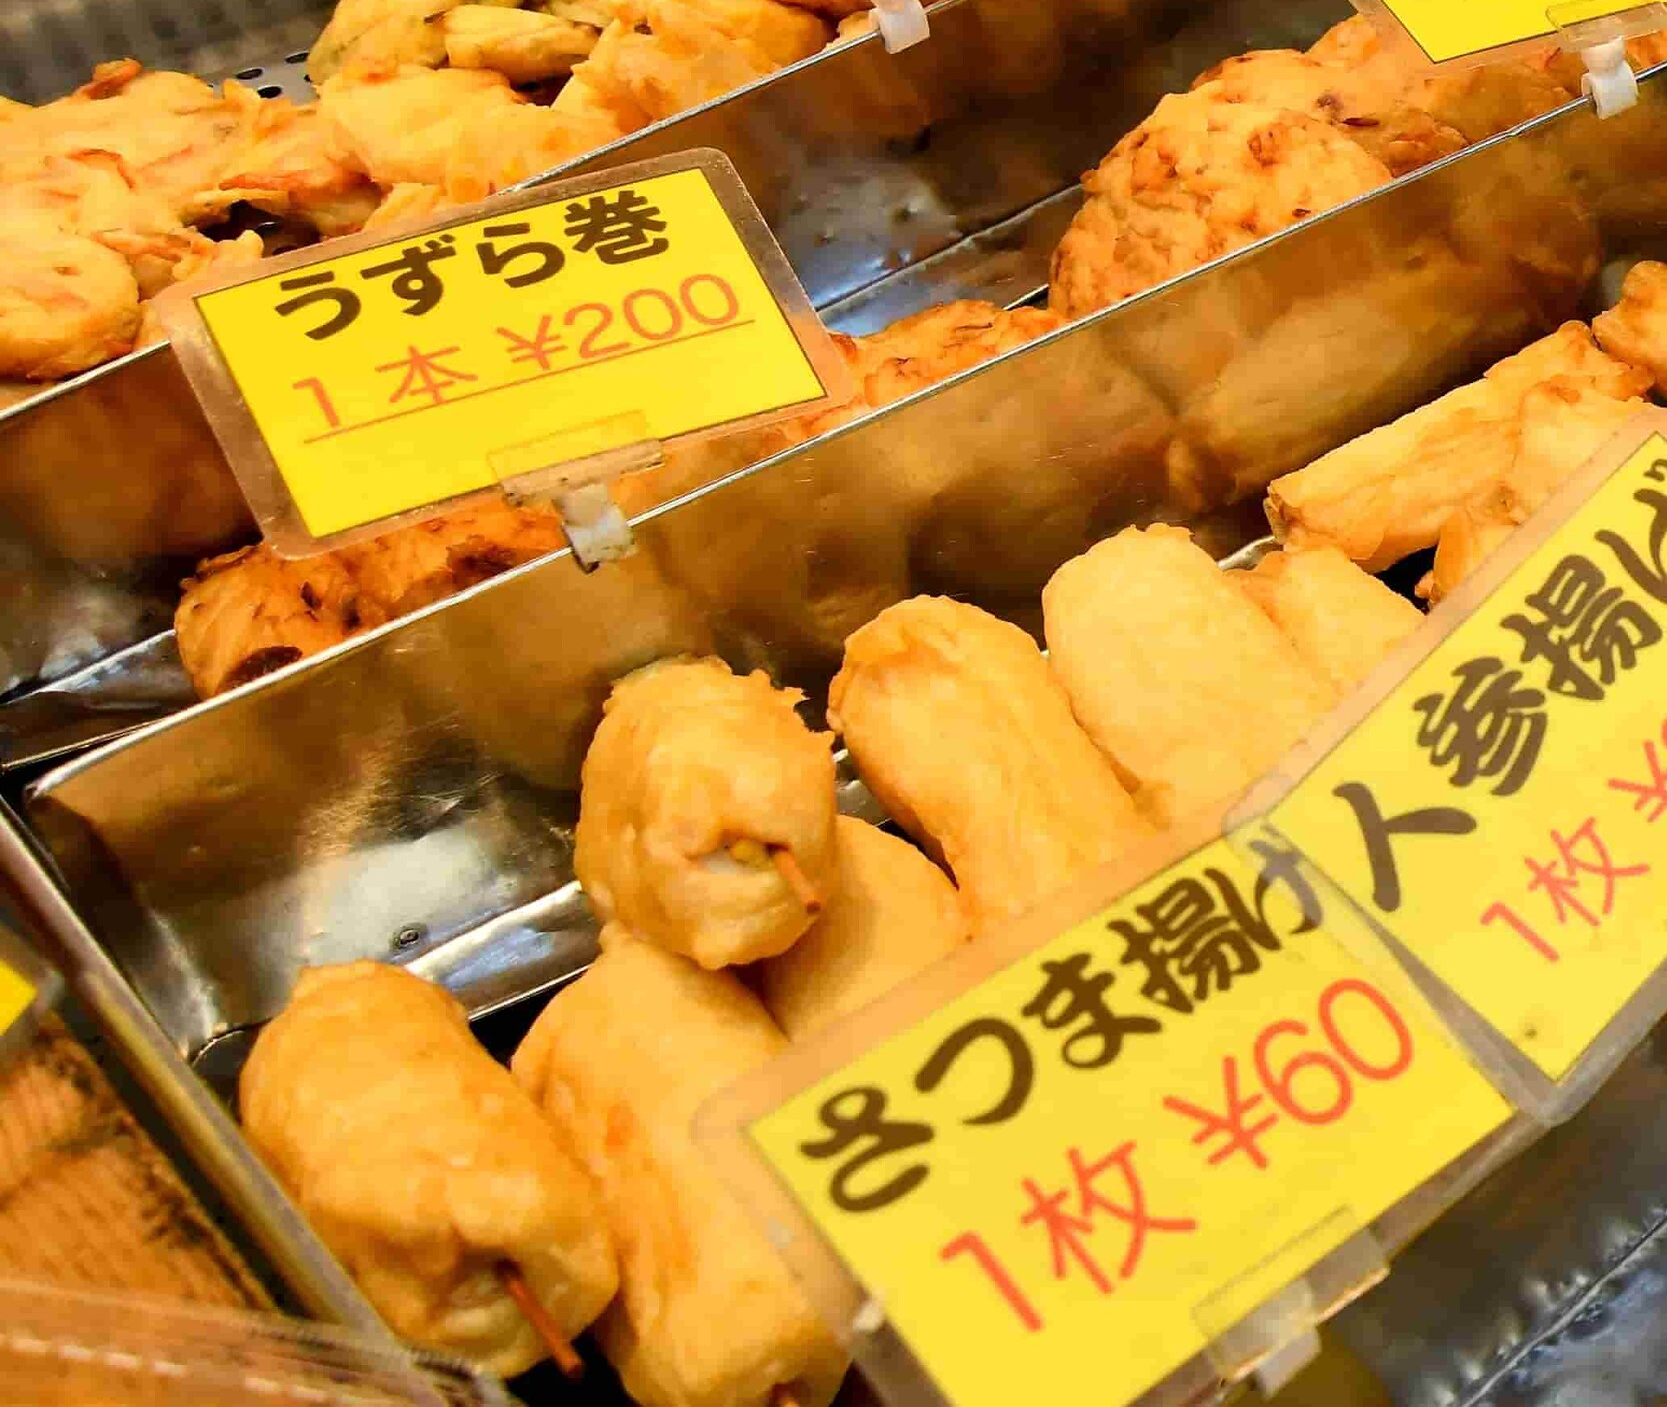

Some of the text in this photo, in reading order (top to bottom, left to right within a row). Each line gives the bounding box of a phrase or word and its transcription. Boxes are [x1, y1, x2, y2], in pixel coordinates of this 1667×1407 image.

[274, 190, 671, 341] うずら巻
[496, 273, 740, 372] ¥200
[797, 822, 1326, 1214] さつま揚げ
[1163, 978, 1415, 1170] ¥60
